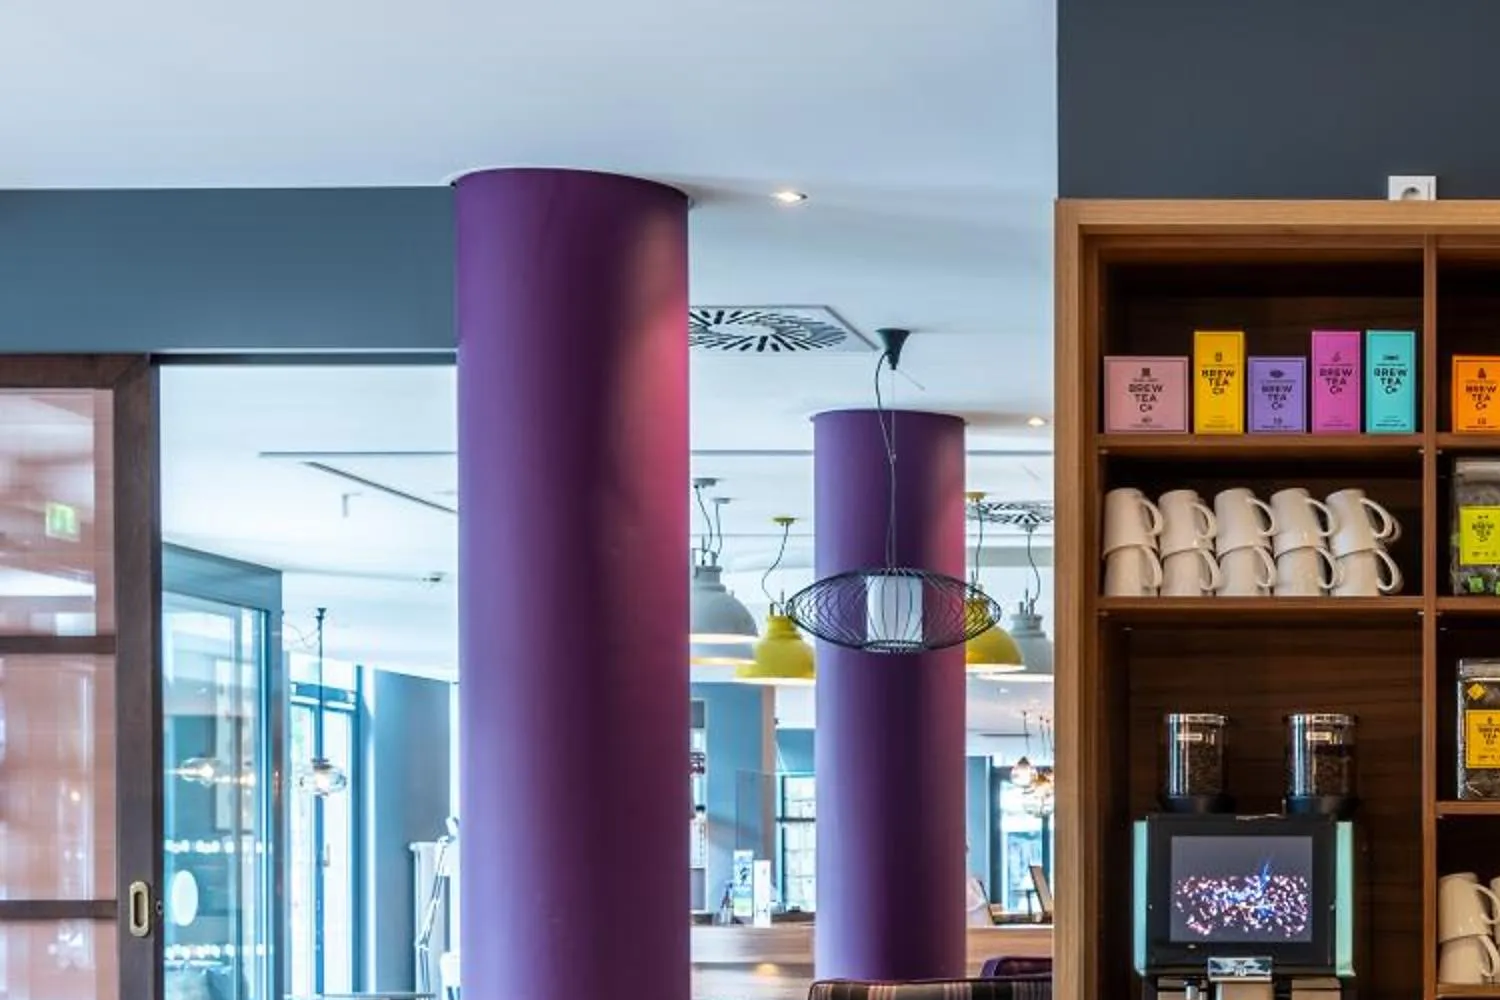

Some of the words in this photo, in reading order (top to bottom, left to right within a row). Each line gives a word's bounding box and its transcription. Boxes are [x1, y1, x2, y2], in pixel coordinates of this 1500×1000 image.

[1201, 369, 1235, 378] BREW
[1319, 368, 1353, 377] BREW
[1374, 368, 1408, 377] BREW
[1208, 378, 1229, 386] TEA
[1325, 377, 1347, 386] TEA
[1380, 377, 1402, 386] TEA
[1128, 384, 1164, 393] BREW
[1261, 385, 1293, 394] BREW
[1465, 385, 1497, 393] BREW
[1134, 393, 1157, 403] TEA
[1267, 393, 1287, 402] TEA
[1472, 394, 1491, 402] TEA
